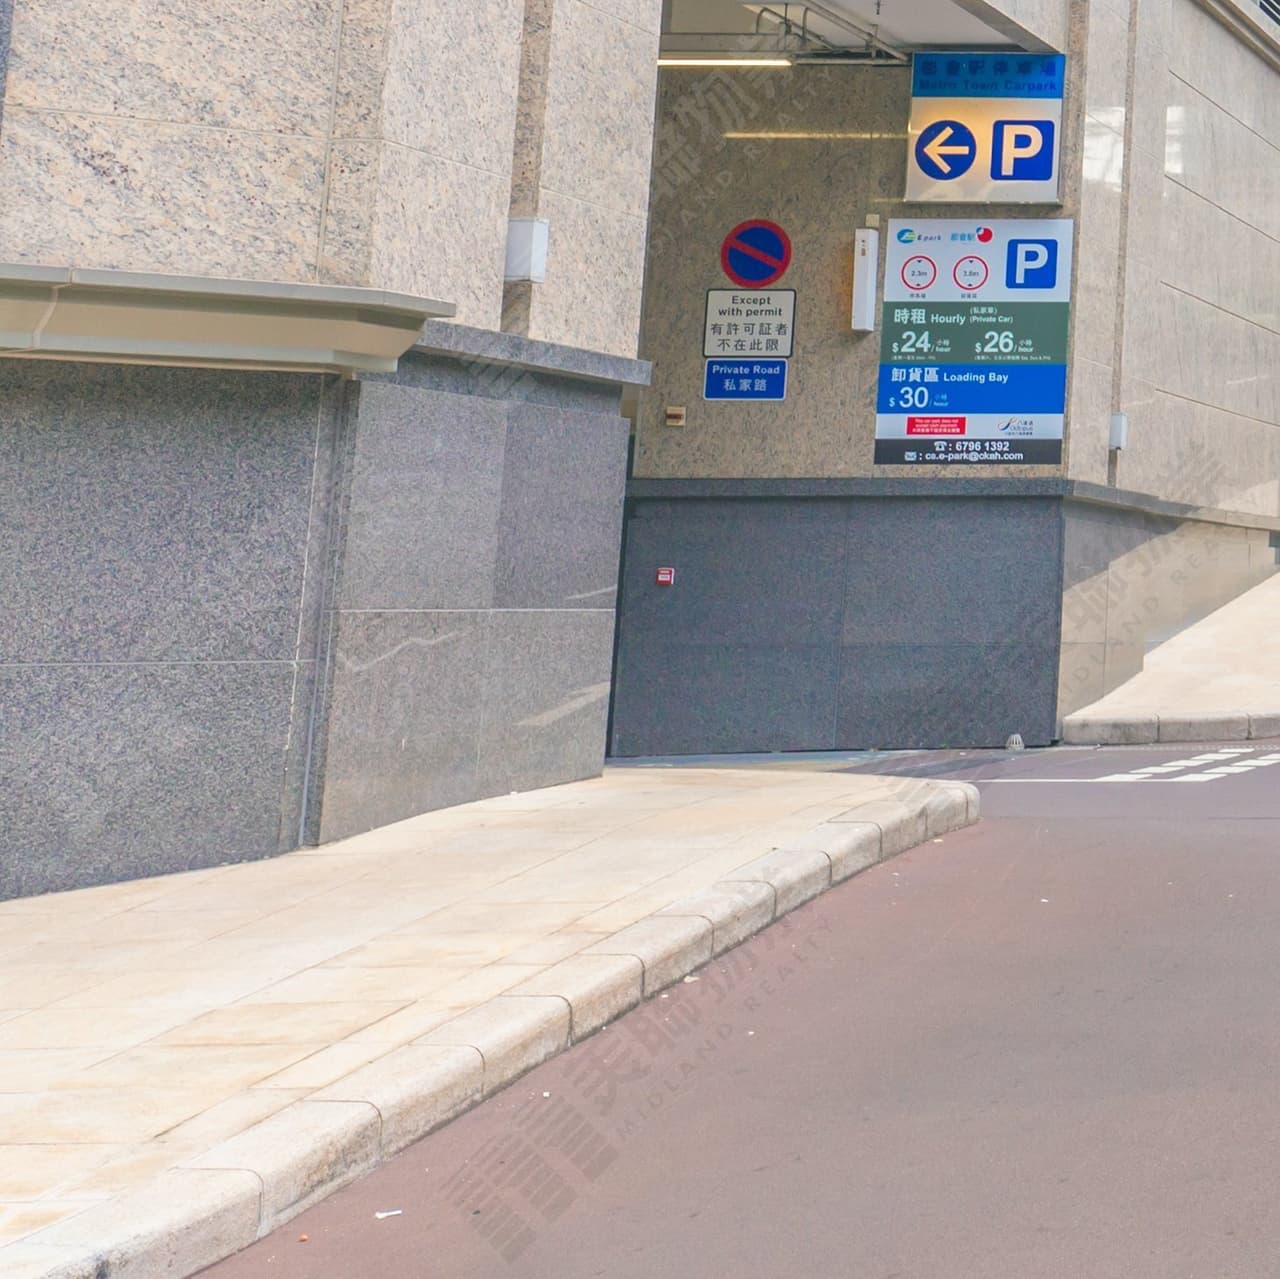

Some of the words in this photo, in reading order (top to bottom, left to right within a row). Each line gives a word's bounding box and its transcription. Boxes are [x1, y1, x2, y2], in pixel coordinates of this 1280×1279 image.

[963, 79, 998, 90] Town
[1004, 79, 1057, 92] Carpark
[1001, 124, 1043, 176] P
[1015, 243, 1049, 284] P
[731, 296, 771, 306] Except
[718, 307, 742, 316] with
[746, 307, 783, 318] permit
[894, 308, 926, 324] 時租
[931, 314, 966, 325] Hourly
[711, 322, 789, 336] 有許可証者
[717, 338, 779, 352] 不在此限
[712, 365, 750, 375] Private
[753, 365, 780, 375] Road
[891, 367, 939, 383] 卸貨區
[944, 372, 985, 384] Loading
[989, 372, 1009, 384] Bay
[723, 378, 767, 391] 私家路
[955, 441, 981, 451] 6796
[984, 441, 1010, 451] 1392
